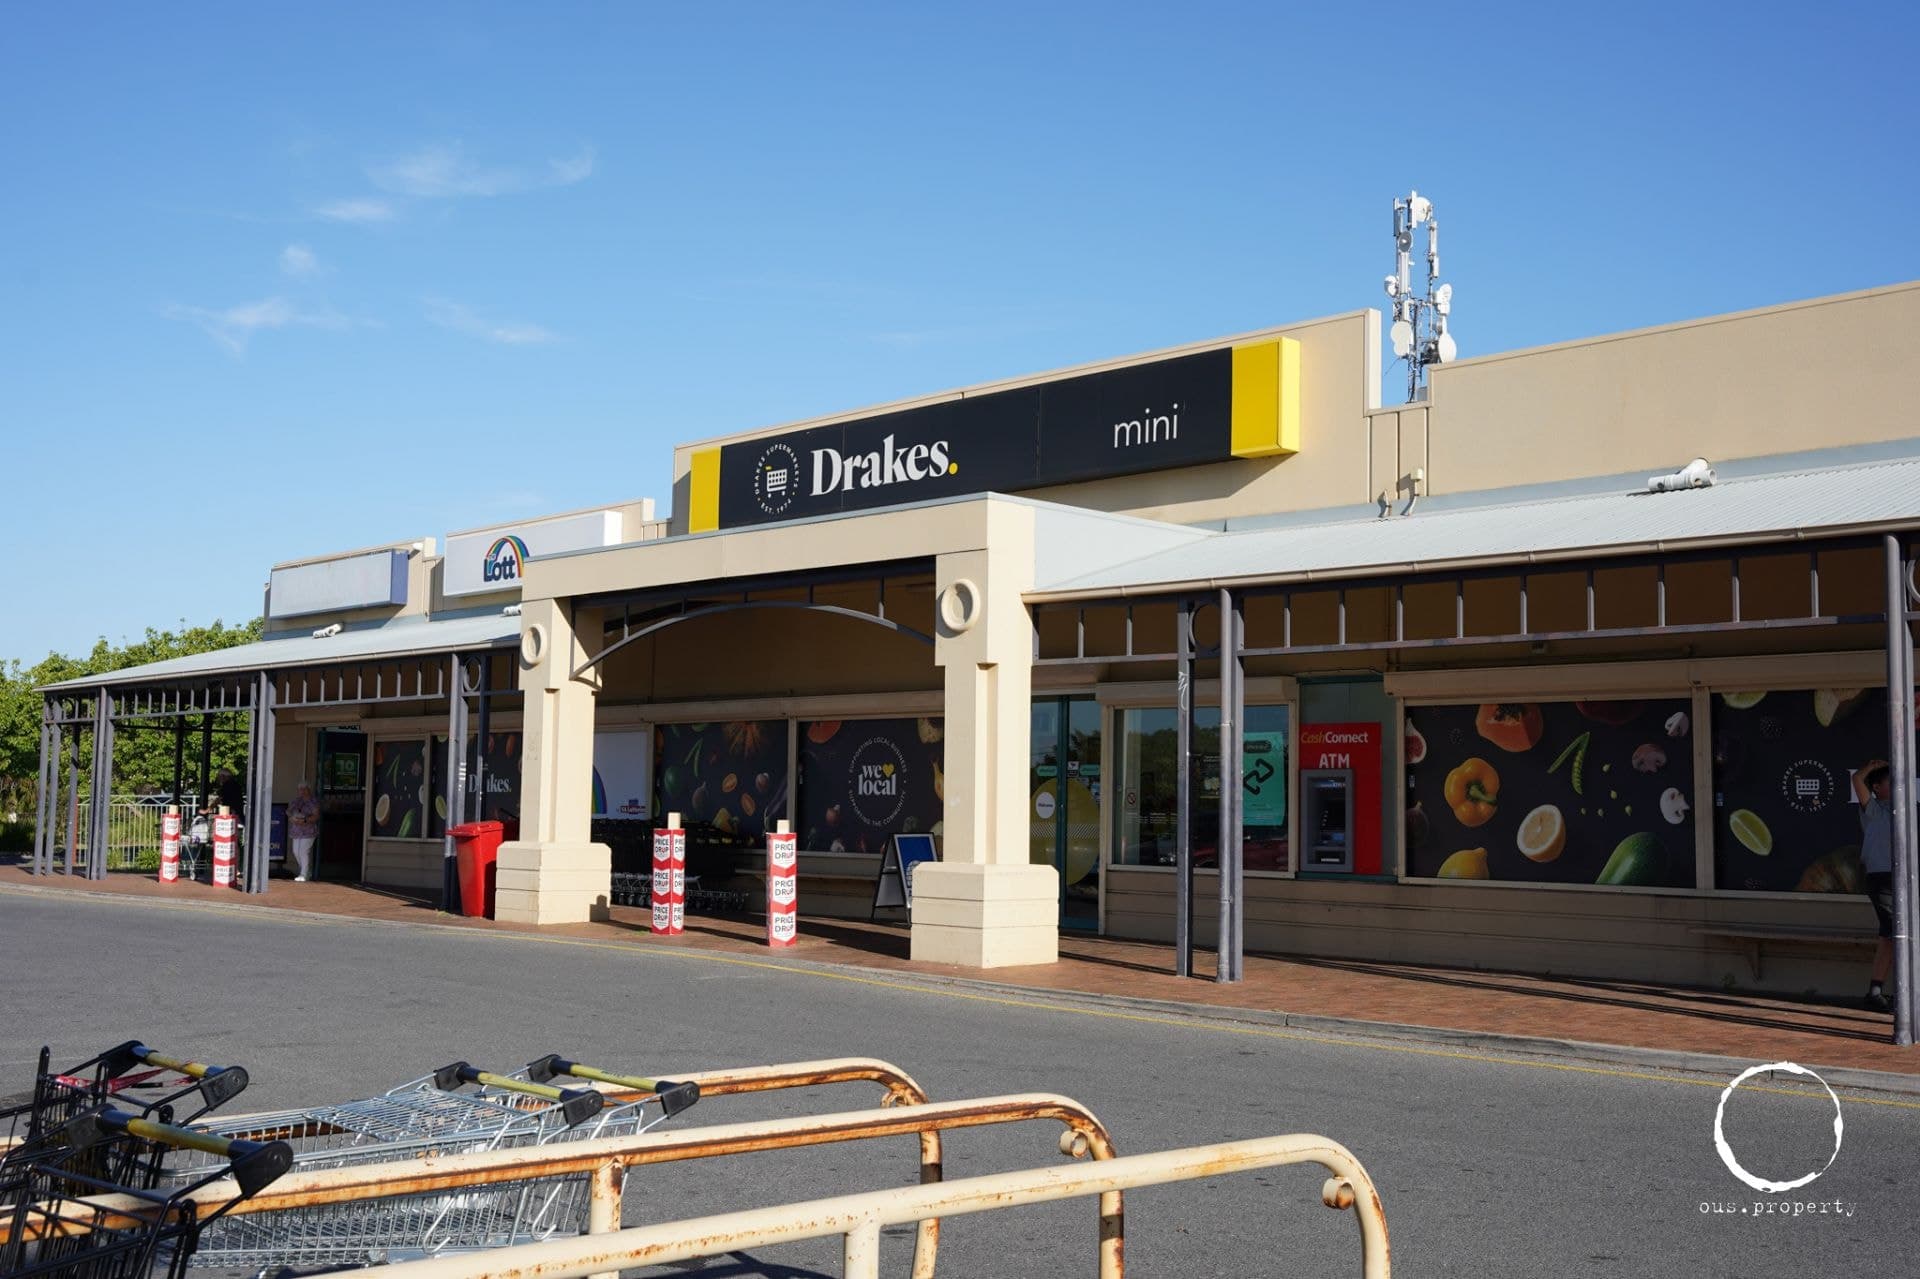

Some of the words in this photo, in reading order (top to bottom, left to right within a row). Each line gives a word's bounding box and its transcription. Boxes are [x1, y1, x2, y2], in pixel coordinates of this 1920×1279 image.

[1114, 403, 1178, 448] mini
[484, 555, 516, 582] Lott
[1301, 731, 1369, 744] CashConnect
[1319, 753, 1350, 769] ATM
[862, 765, 882, 779] we
[858, 773, 897, 796] local
